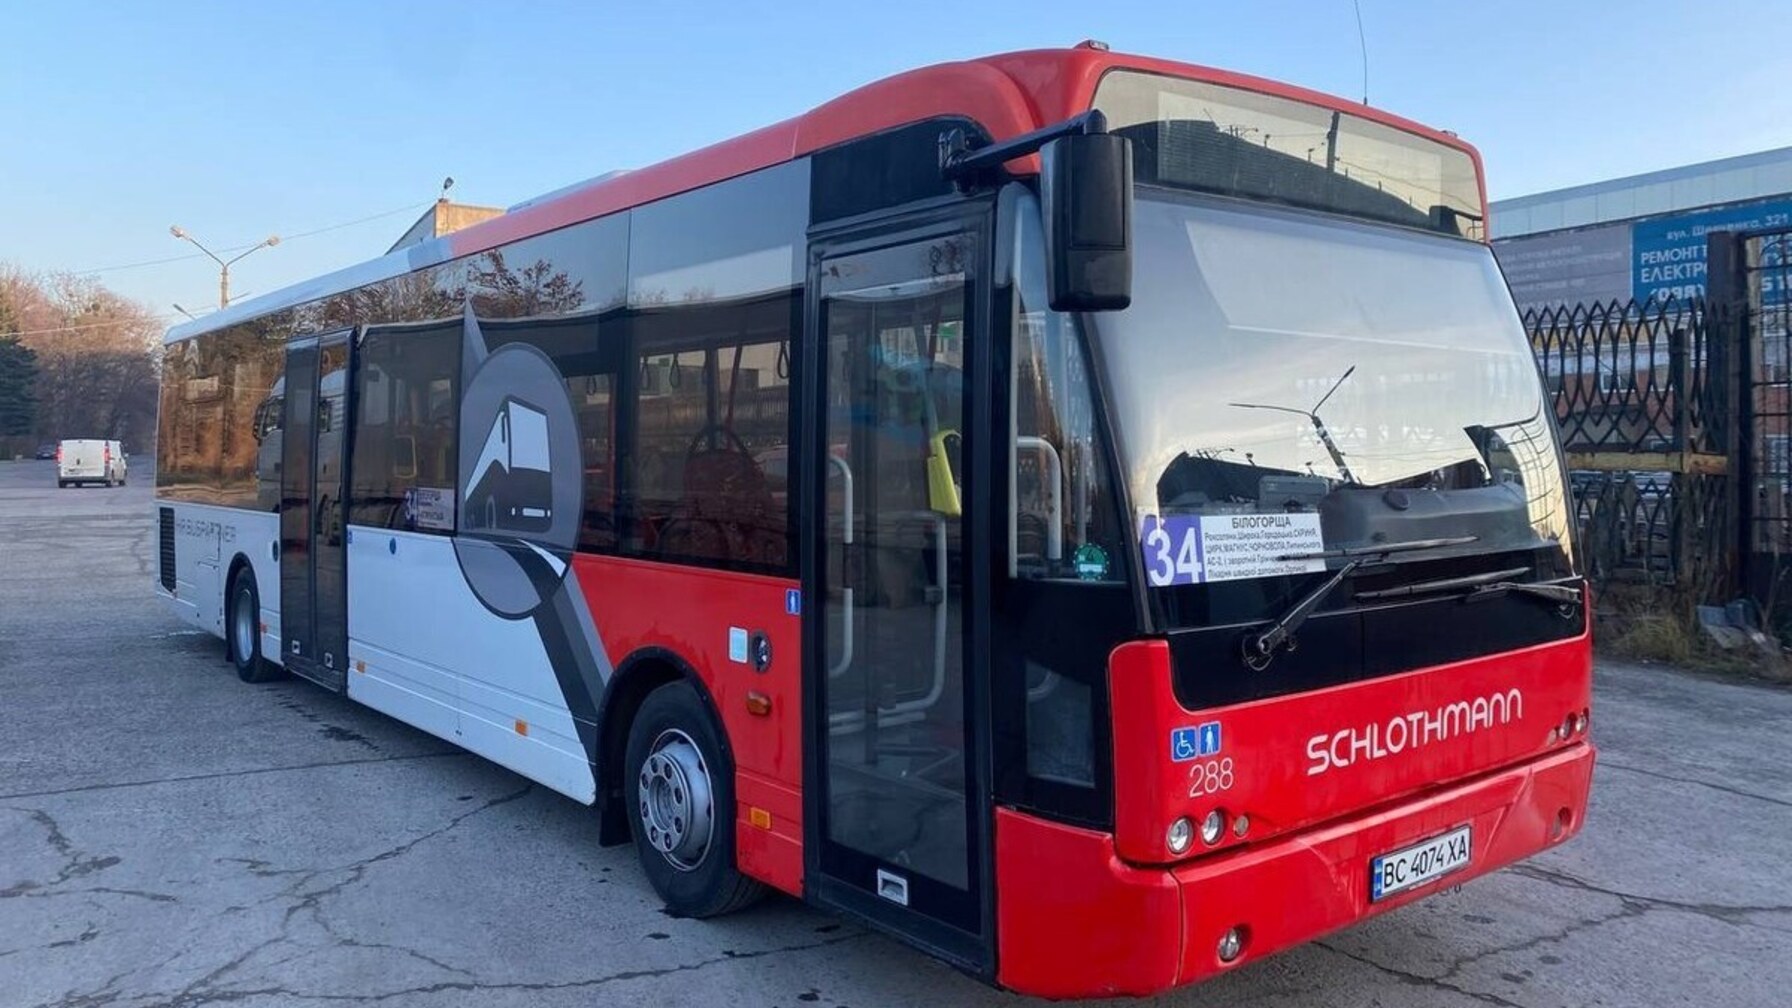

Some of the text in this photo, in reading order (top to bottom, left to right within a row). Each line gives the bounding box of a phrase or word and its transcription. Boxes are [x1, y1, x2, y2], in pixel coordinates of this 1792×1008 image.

[1641, 245, 1701, 265] РЕМОНТ
[1667, 230, 1690, 241] вул.
[1232, 516, 1291, 529] БІЛОГОРЩА
[1147, 527, 1203, 587] 34
[1305, 688, 1522, 776] SCHLOTHMANN
[1189, 758, 1234, 797] 288
[1384, 835, 1467, 889] BC 4074 XA
